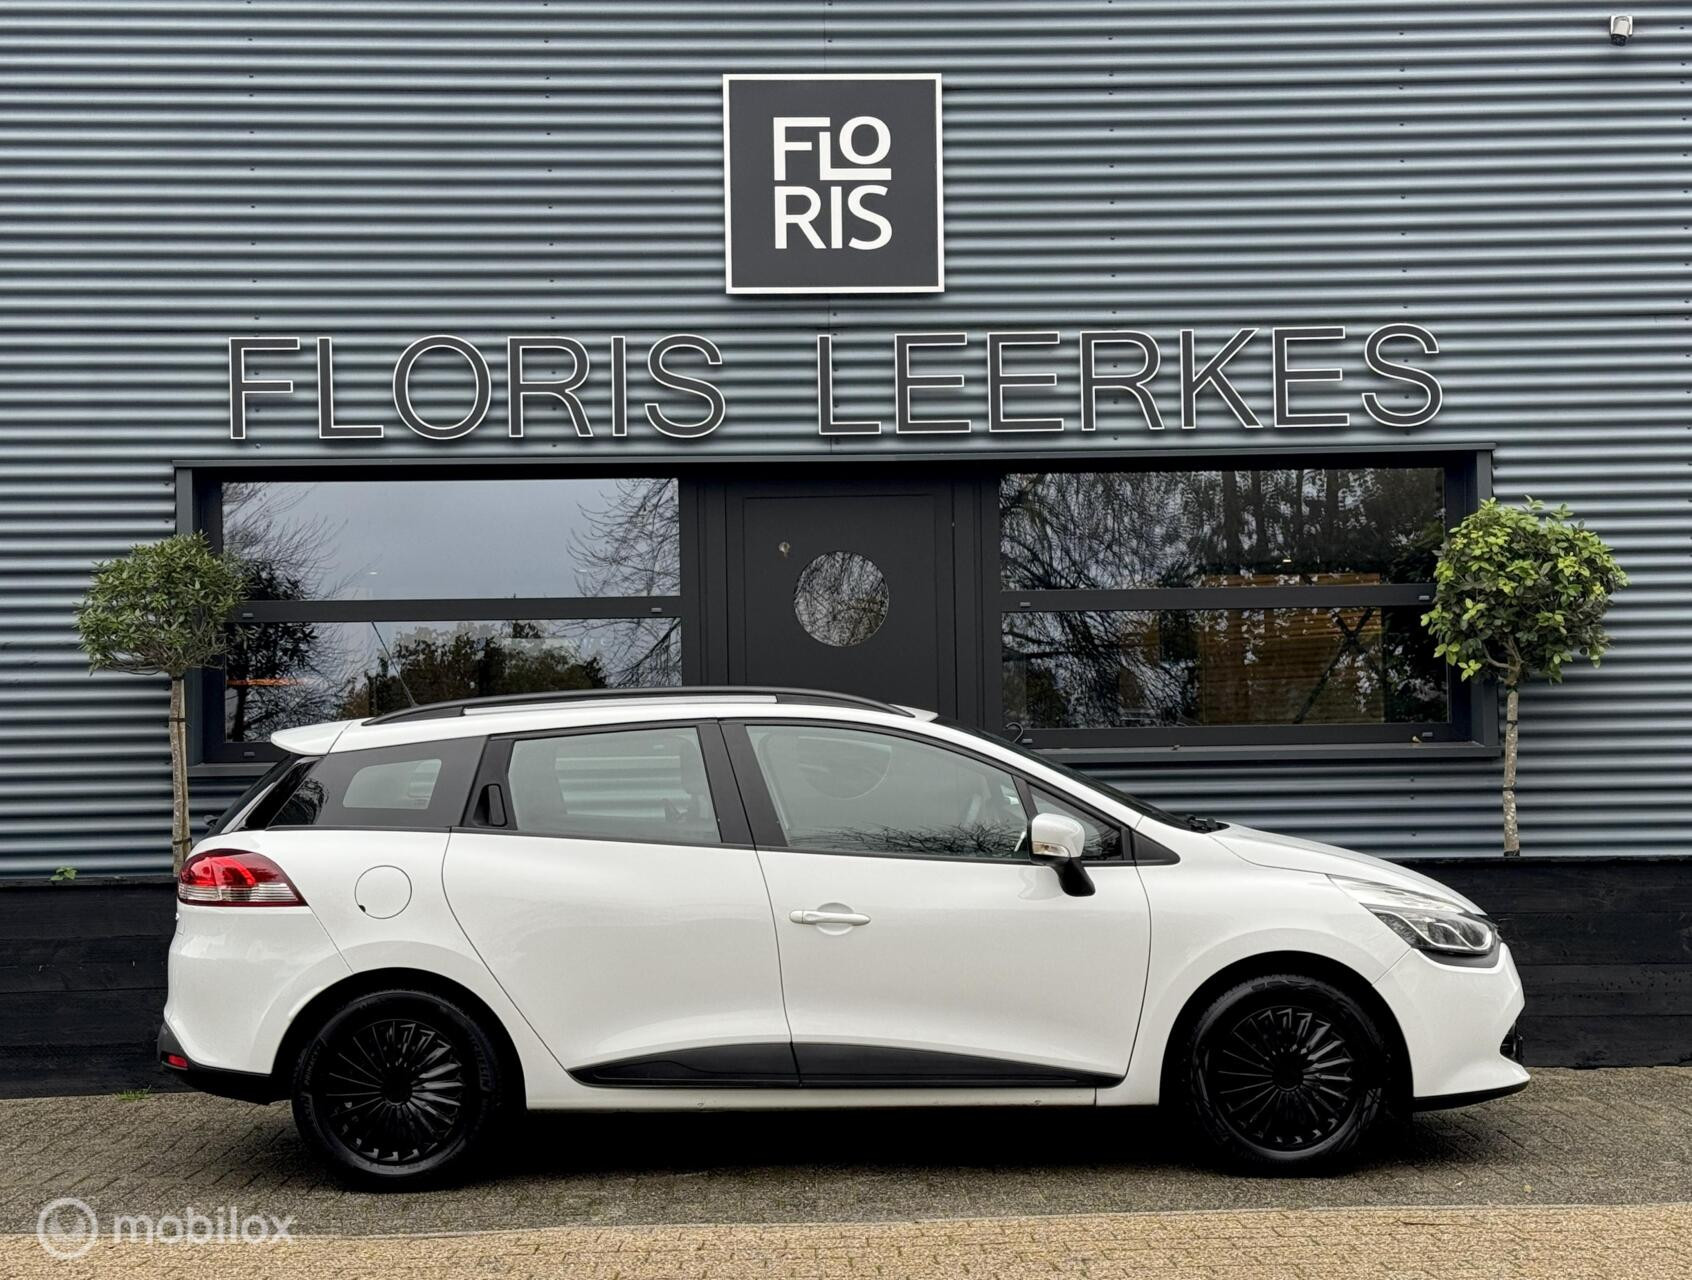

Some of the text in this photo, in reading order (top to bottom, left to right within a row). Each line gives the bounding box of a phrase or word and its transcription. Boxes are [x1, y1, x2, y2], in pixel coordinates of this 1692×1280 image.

[773, 115, 892, 181] FLO
[773, 184, 893, 251] RIS
[228, 323, 1443, 440] FLORIS LEERKES
